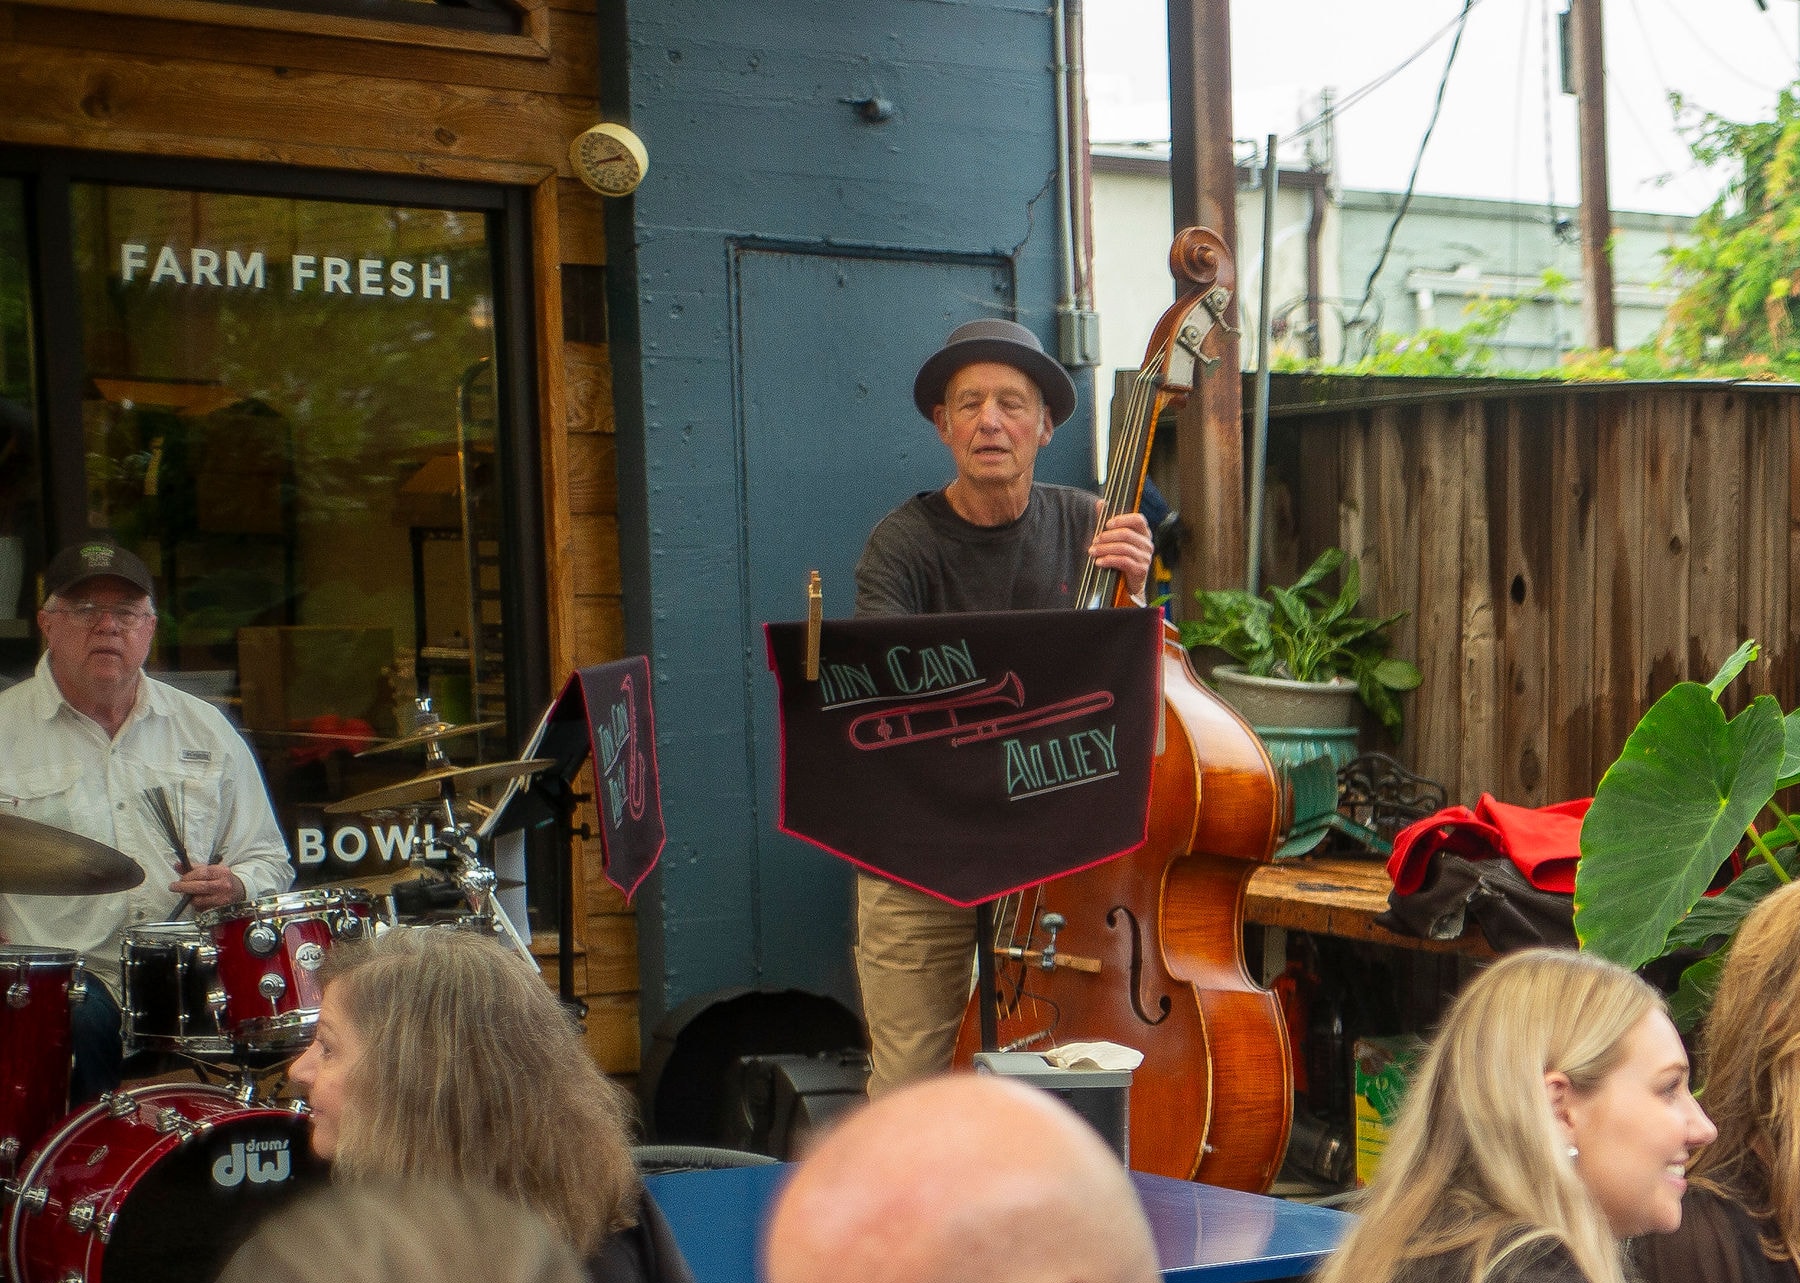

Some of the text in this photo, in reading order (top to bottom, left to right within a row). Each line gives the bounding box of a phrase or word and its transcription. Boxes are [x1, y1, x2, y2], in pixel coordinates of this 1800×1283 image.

[121, 243, 450, 300] FARM FRESH
[887, 639, 978, 694] CAN
[1003, 724, 1119, 795] ALLEY
[212, 1143, 291, 1187] dw
[245, 1139, 290, 1153] drums
